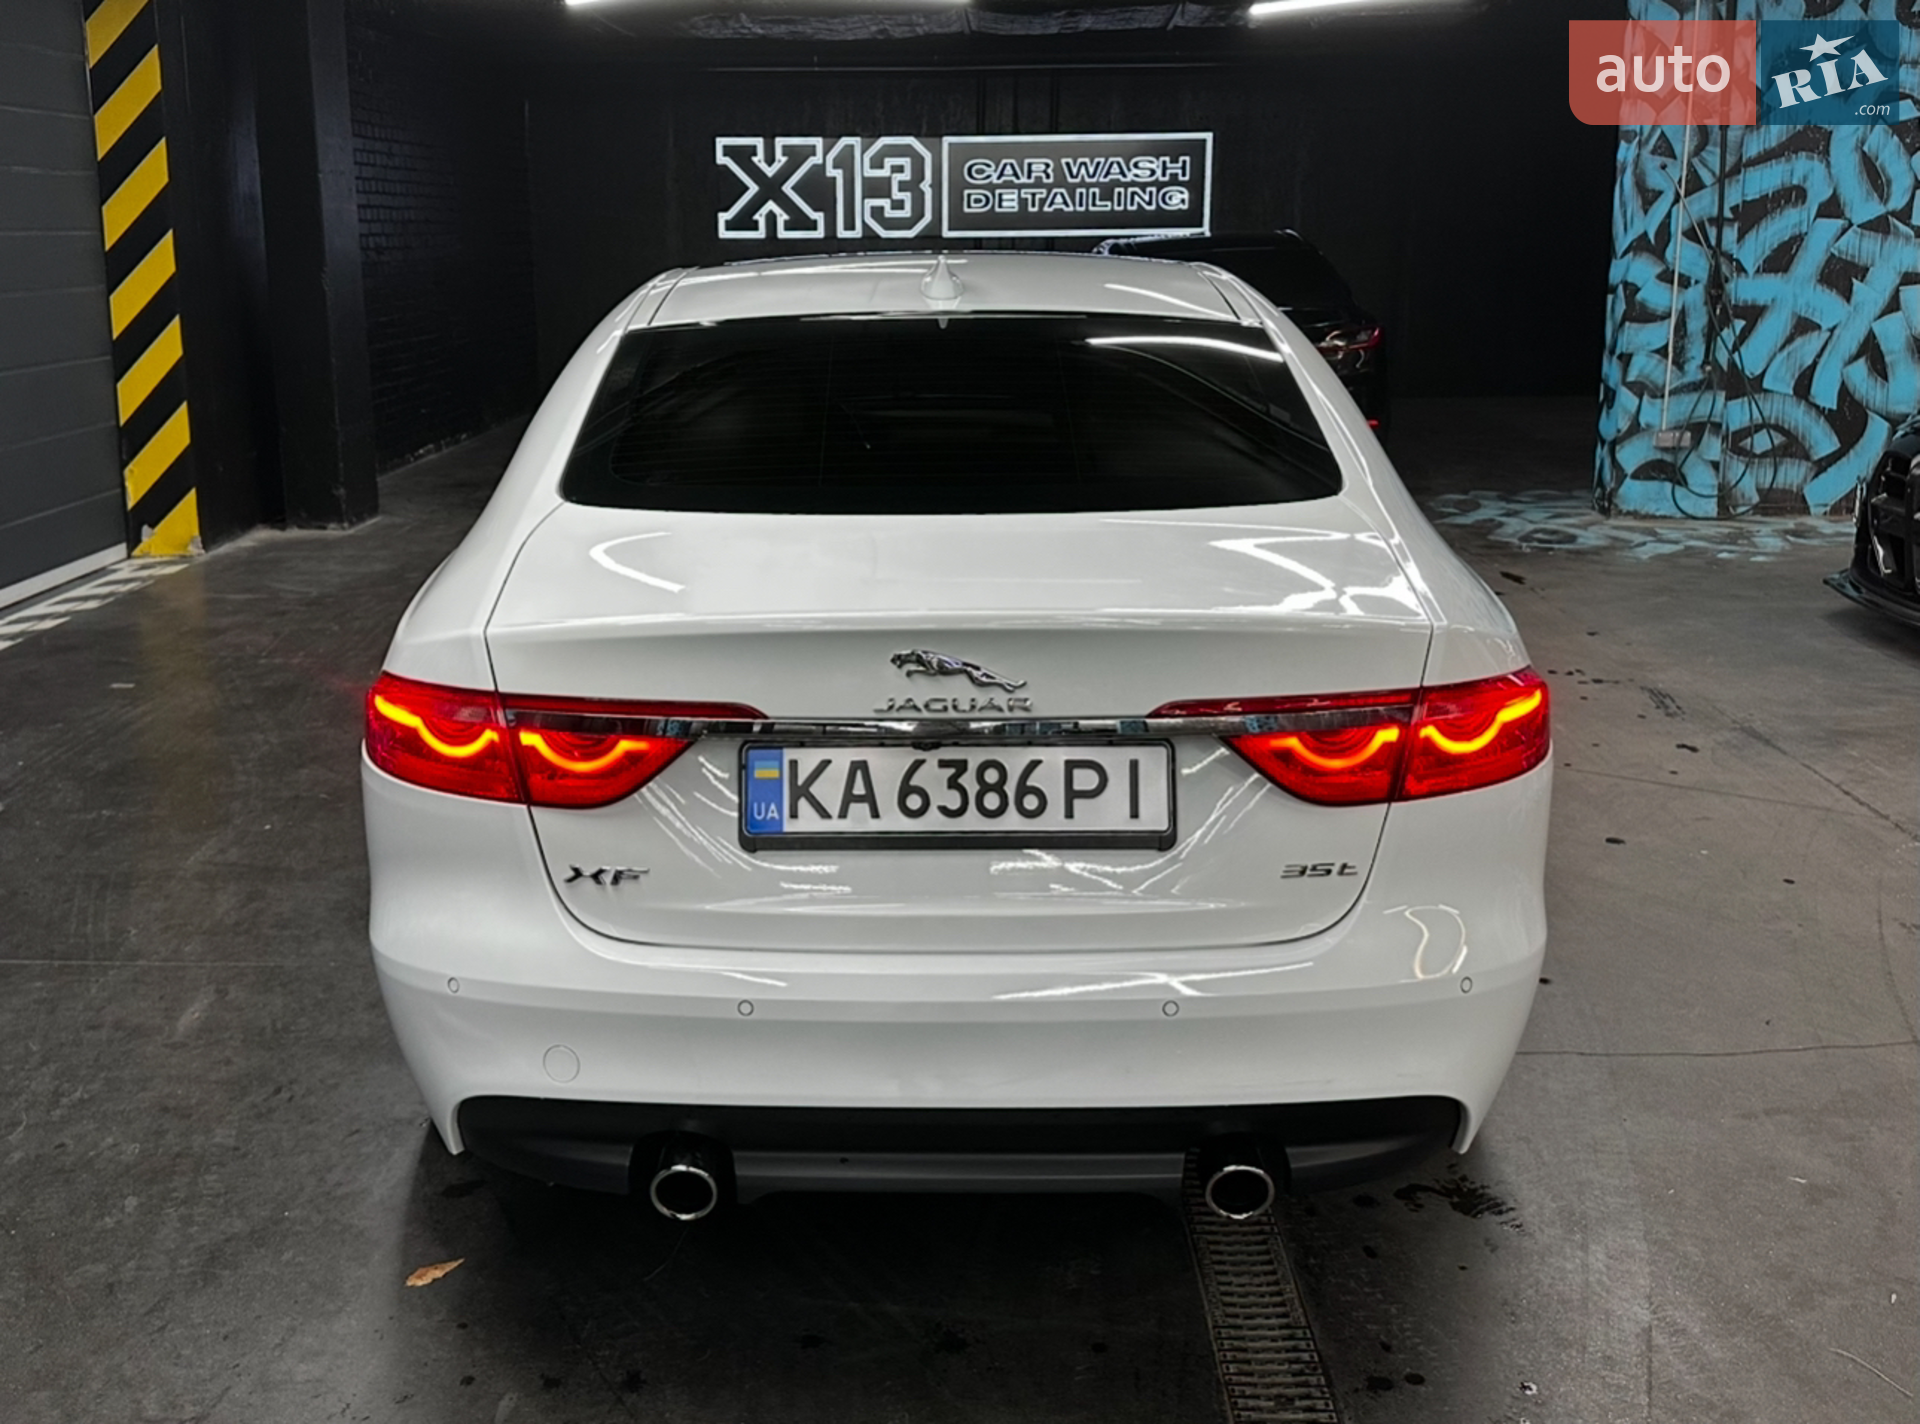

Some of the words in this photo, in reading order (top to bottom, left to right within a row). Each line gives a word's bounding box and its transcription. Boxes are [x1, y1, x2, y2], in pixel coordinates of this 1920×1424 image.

[963, 157, 1054, 184] CAR
[1060, 155, 1190, 183] WASH
[715, 136, 933, 239] X13
[963, 185, 1190, 213] DETAILING
[873, 697, 1034, 713] JAGUAR
[788, 758, 881, 819] KA
[897, 758, 1048, 819] 6386
[1064, 758, 1140, 819] PI
[753, 802, 780, 820] UA
[564, 864, 650, 886] XF
[1280, 862, 1359, 878] 35t
